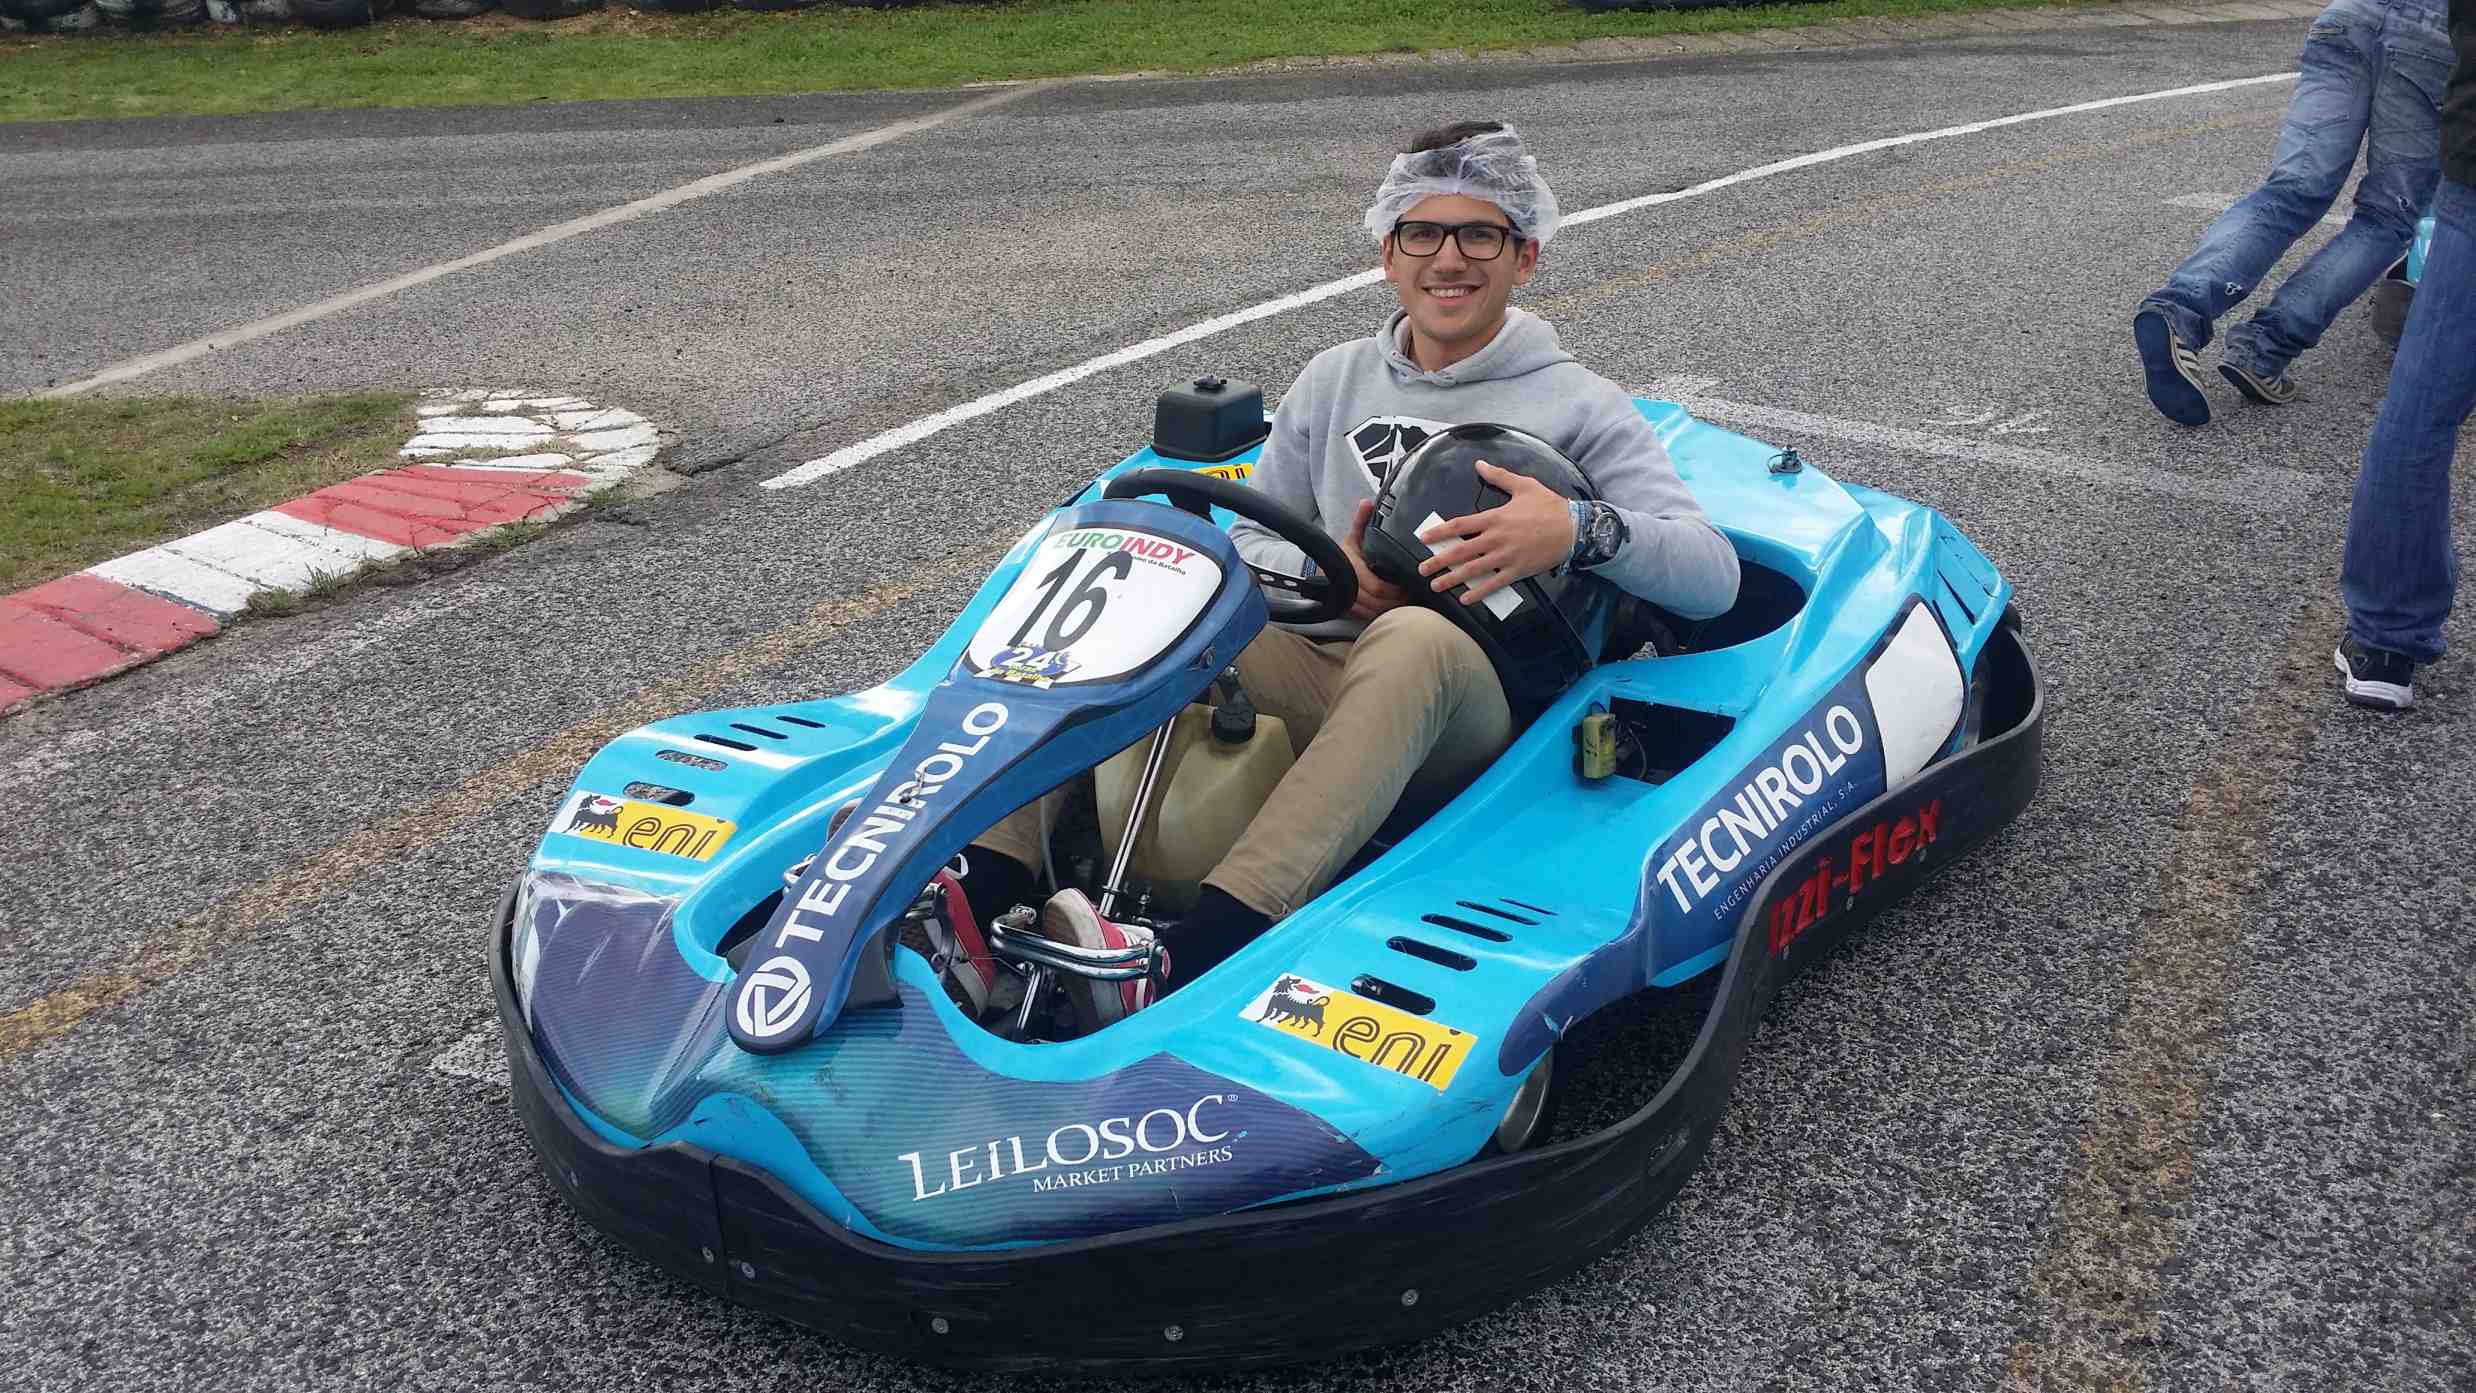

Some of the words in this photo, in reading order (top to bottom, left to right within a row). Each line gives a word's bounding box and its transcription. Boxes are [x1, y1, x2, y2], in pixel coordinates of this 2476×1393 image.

[1054, 532, 1195, 566] EUROINDY
[1006, 548, 1133, 652] 16
[622, 816, 727, 859] eni
[775, 702, 1009, 949] TECNIROLO
[1656, 704, 1864, 915] TECNIROLO
[1713, 855, 1777, 920] ENGENHARIA
[1332, 1016, 1462, 1082] eni
[1032, 1166, 1121, 1193] MARKET
[1128, 1145, 1233, 1178] PARTNERS
